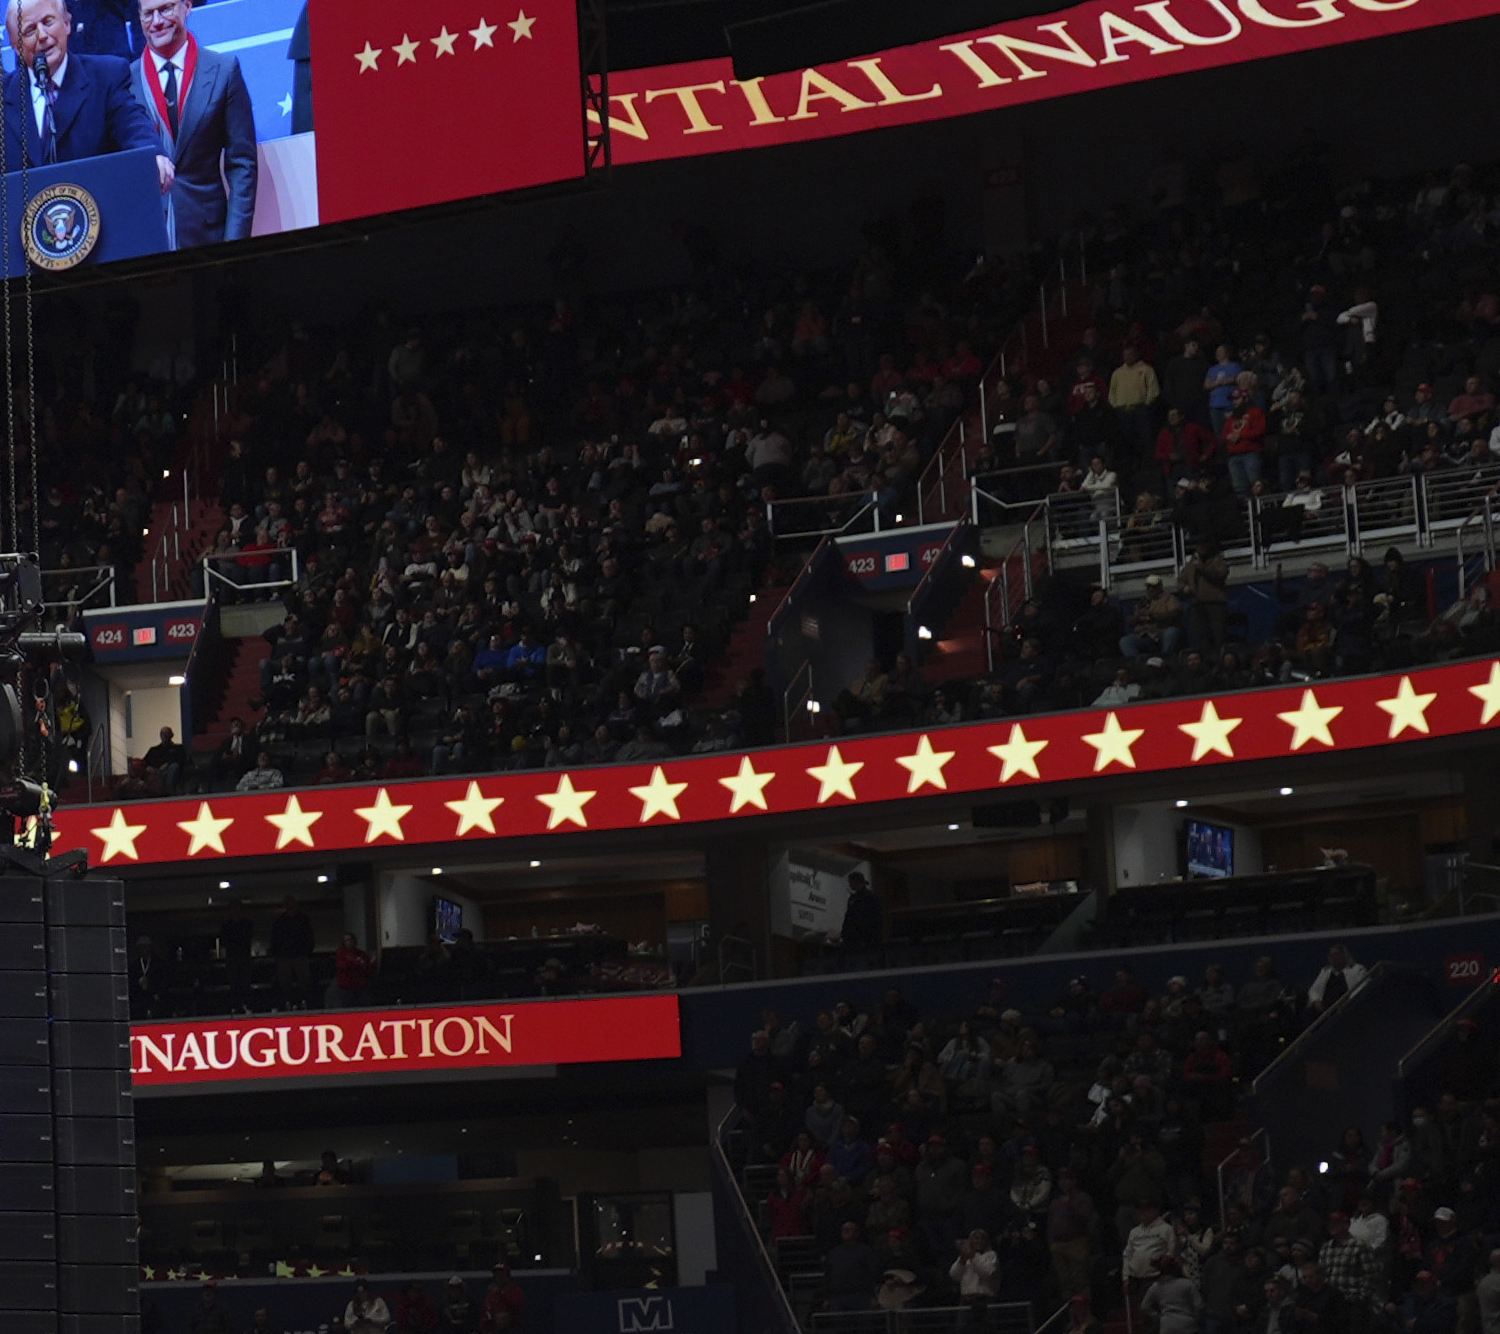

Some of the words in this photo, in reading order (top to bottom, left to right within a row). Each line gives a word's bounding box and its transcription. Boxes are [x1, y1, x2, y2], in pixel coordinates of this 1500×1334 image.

[922, 548, 941, 564] 42
[849, 557, 876, 573] 423
[96, 629, 123, 645] 424
[168, 622, 196, 639] 423
[1450, 961, 1479, 978] 220
